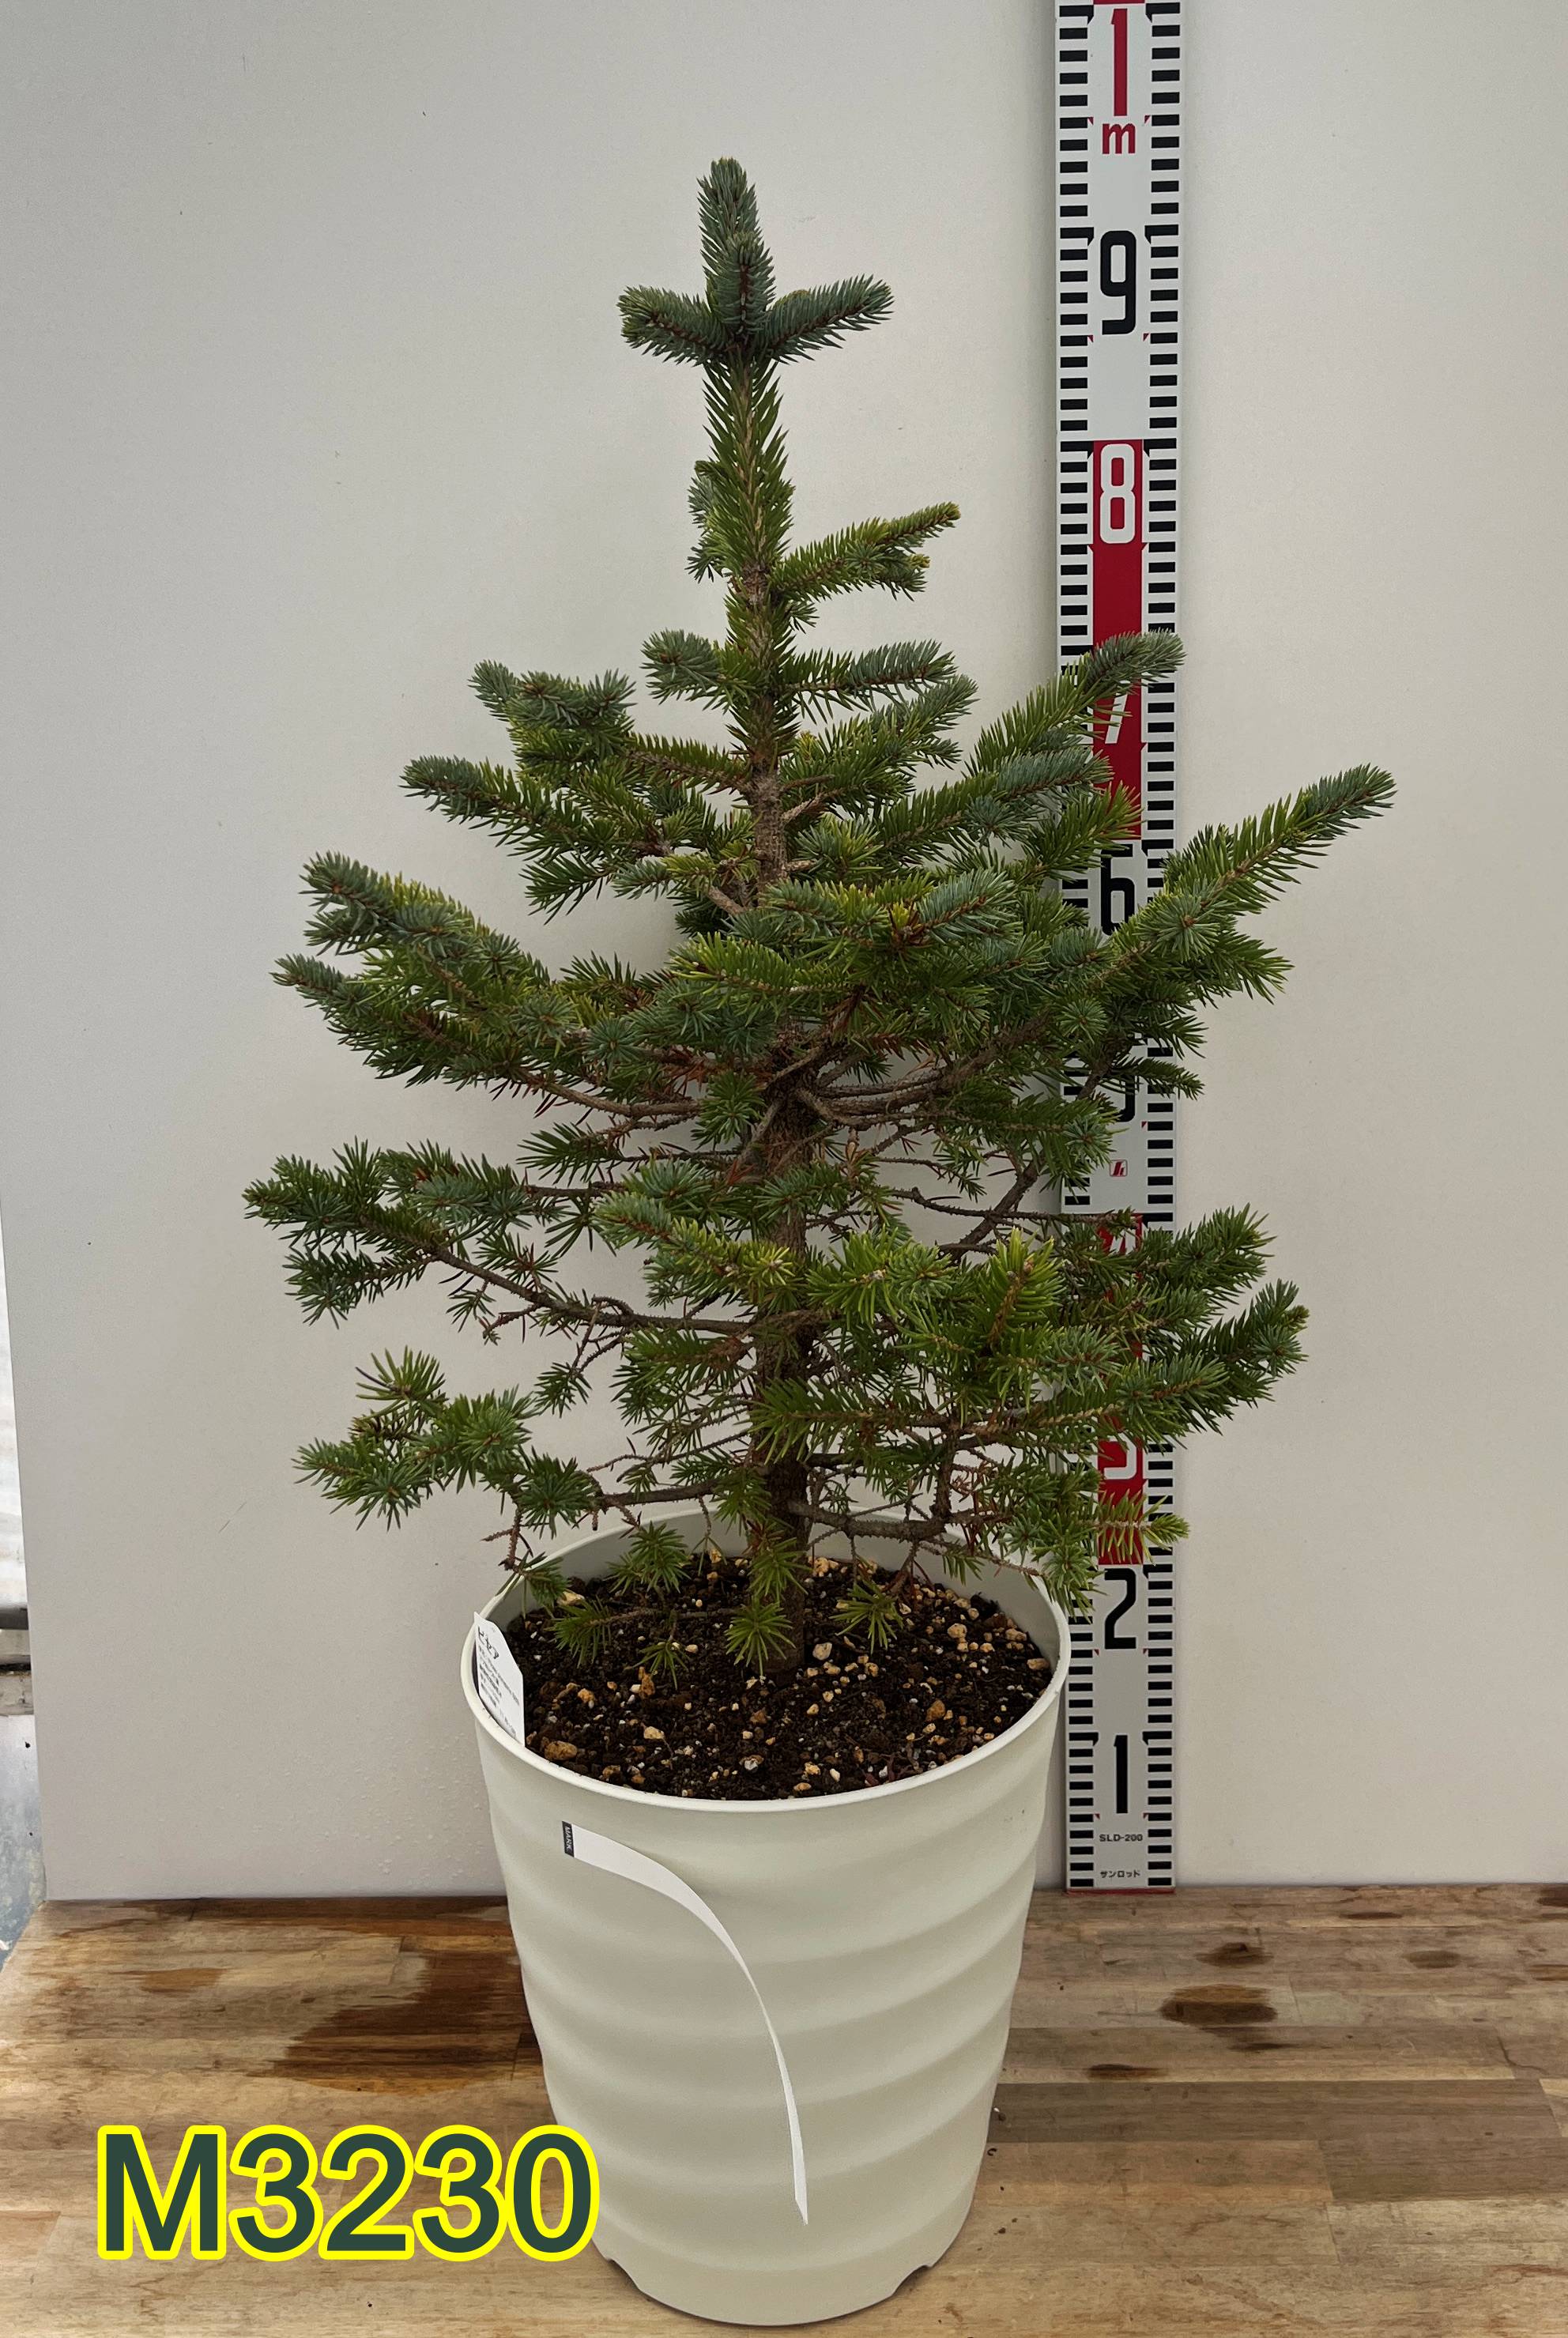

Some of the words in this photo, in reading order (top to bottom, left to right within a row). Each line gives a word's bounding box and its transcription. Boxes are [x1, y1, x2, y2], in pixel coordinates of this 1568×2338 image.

[1111, 8, 1128, 116] 1
[1102, 123, 1136, 154] m
[1100, 230, 1136, 335] 9
[1099, 443, 1136, 544] 8
[1100, 843, 1135, 936] 6
[1104, 1567, 1136, 1650] 2
[1113, 1734, 1129, 1814] 1
[1099, 1833, 1144, 1842] SLD-200
